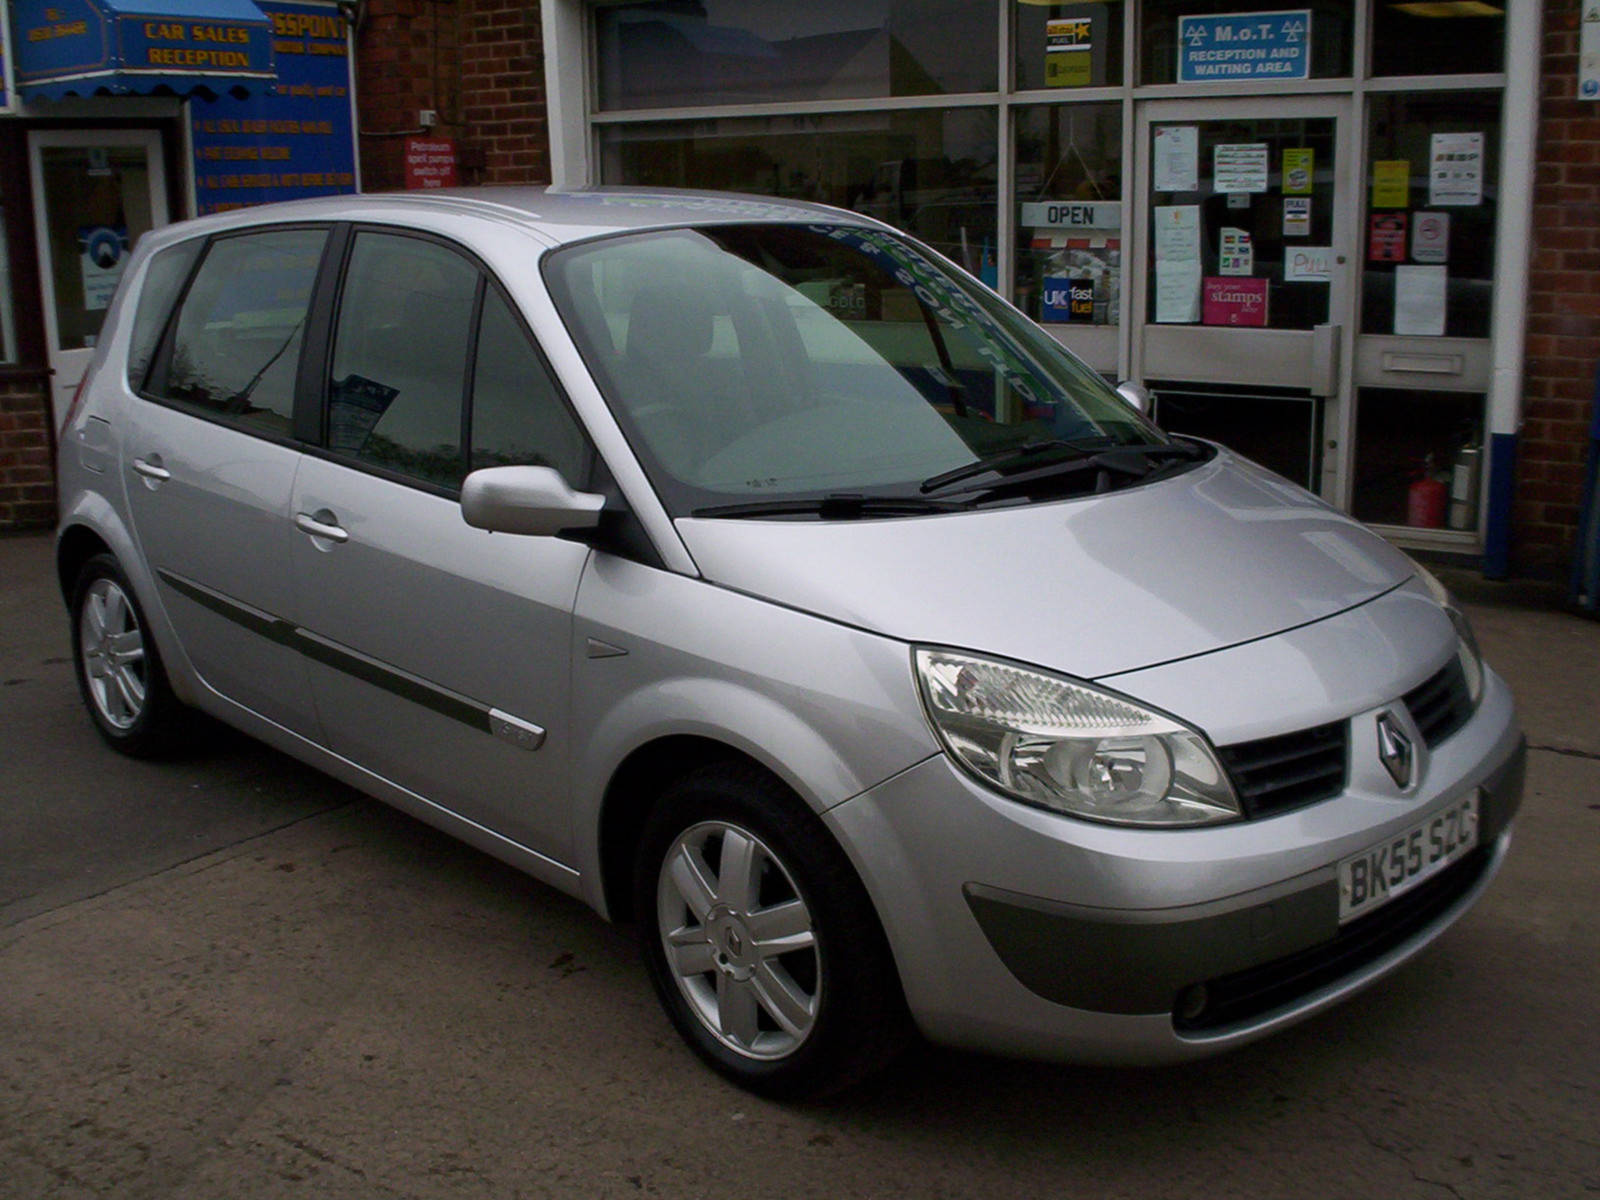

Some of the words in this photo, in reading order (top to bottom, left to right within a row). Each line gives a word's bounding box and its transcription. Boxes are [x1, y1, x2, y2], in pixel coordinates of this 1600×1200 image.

[144, 23, 185, 41] CAR
[192, 25, 249, 43] SALES
[1215, 24, 1275, 41] M.o.T.
[148, 48, 249, 67] RECEPTION
[1189, 49, 1265, 62] RECEPTION
[1270, 47, 1299, 59] AND
[1194, 63, 1251, 75] WAITING
[1256, 62, 1292, 73] AREA
[1048, 206, 1094, 224] OPEN
[1044, 290, 1068, 305] UK
[1069, 286, 1093, 300] fast
[1211, 291, 1262, 307] stamps
[1072, 300, 1092, 313] fuel
[1350, 829, 1422, 907] BK55
[1430, 800, 1470, 863] SZC
